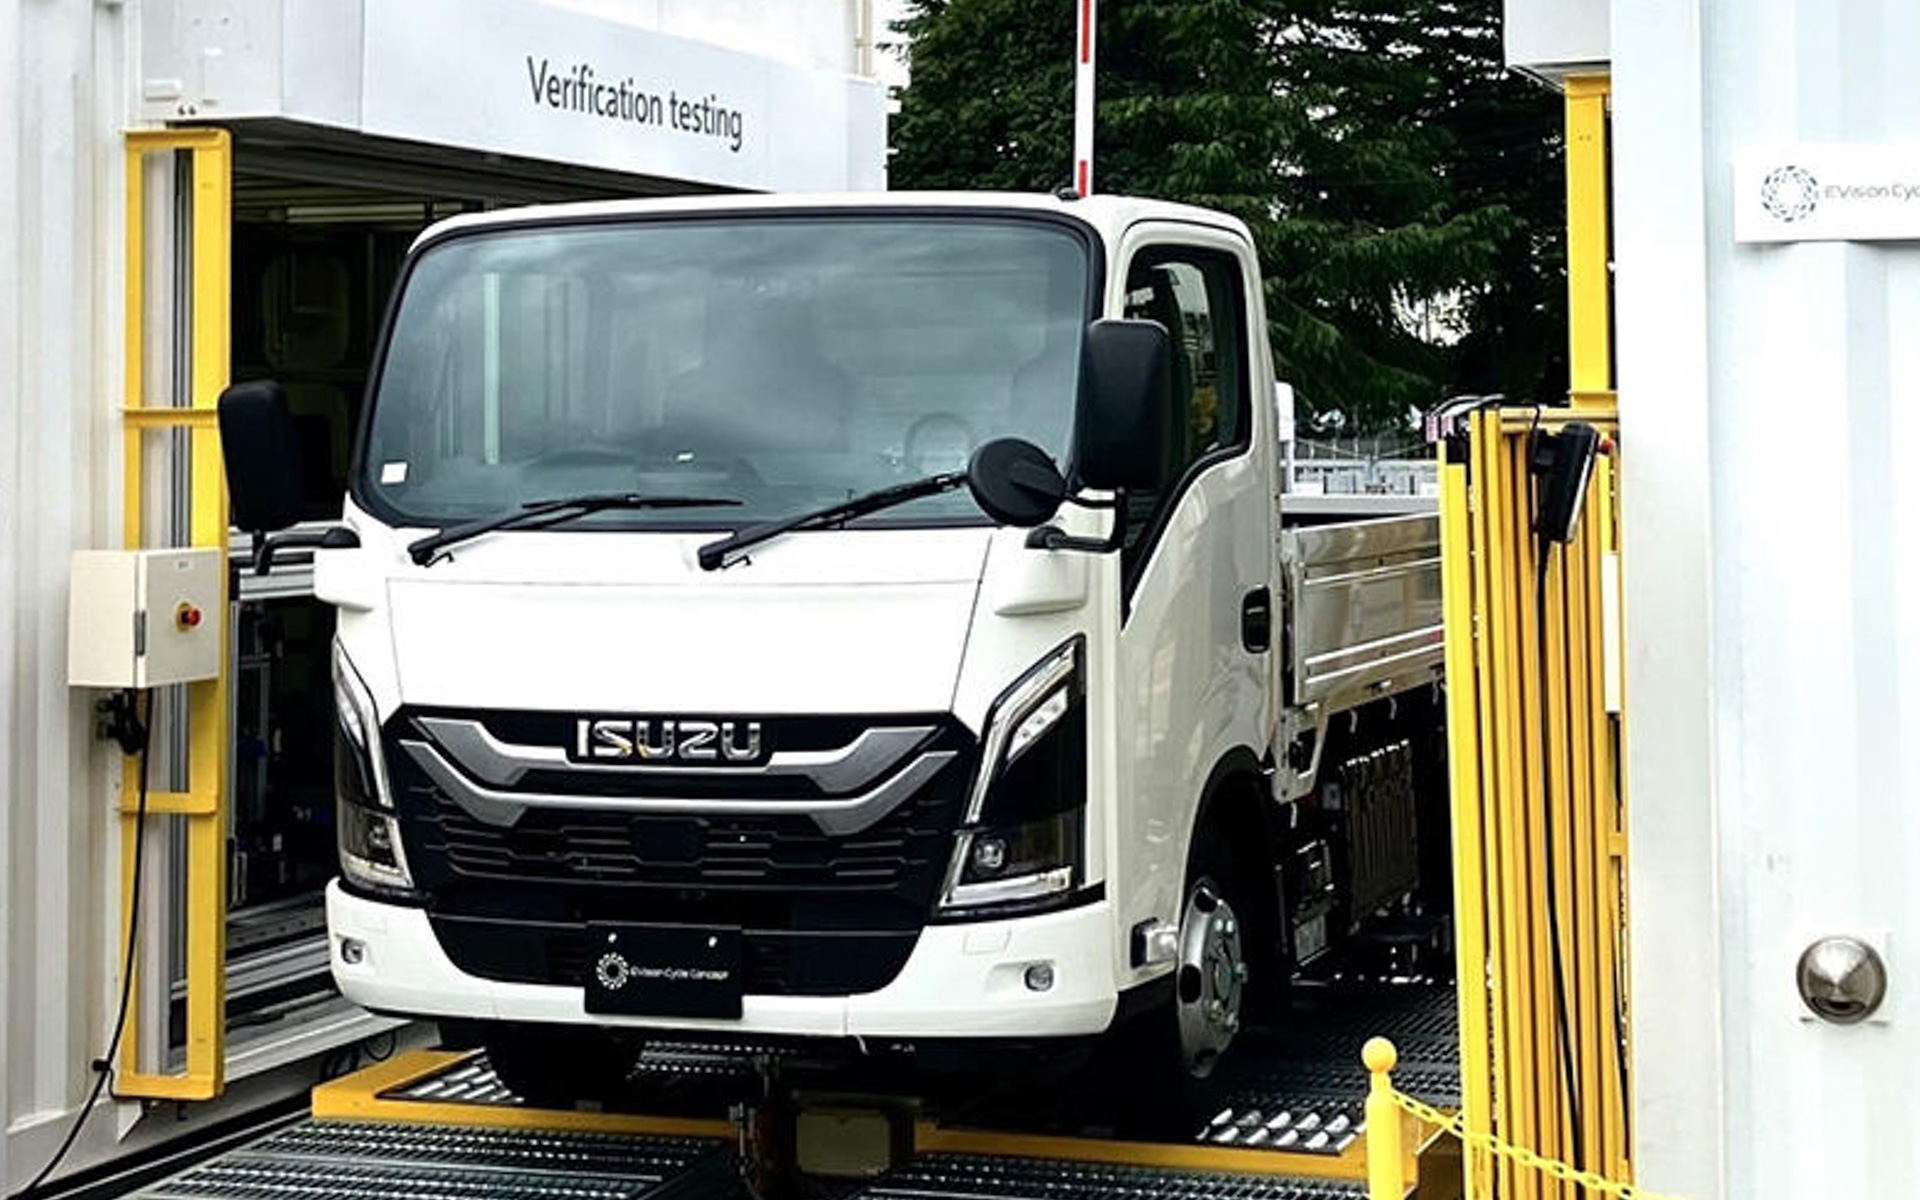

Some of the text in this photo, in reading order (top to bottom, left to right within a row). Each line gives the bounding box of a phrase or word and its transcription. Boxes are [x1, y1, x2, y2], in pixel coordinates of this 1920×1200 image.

[526, 55, 743, 153] Verification testing
[576, 719, 761, 761] ISUZU
